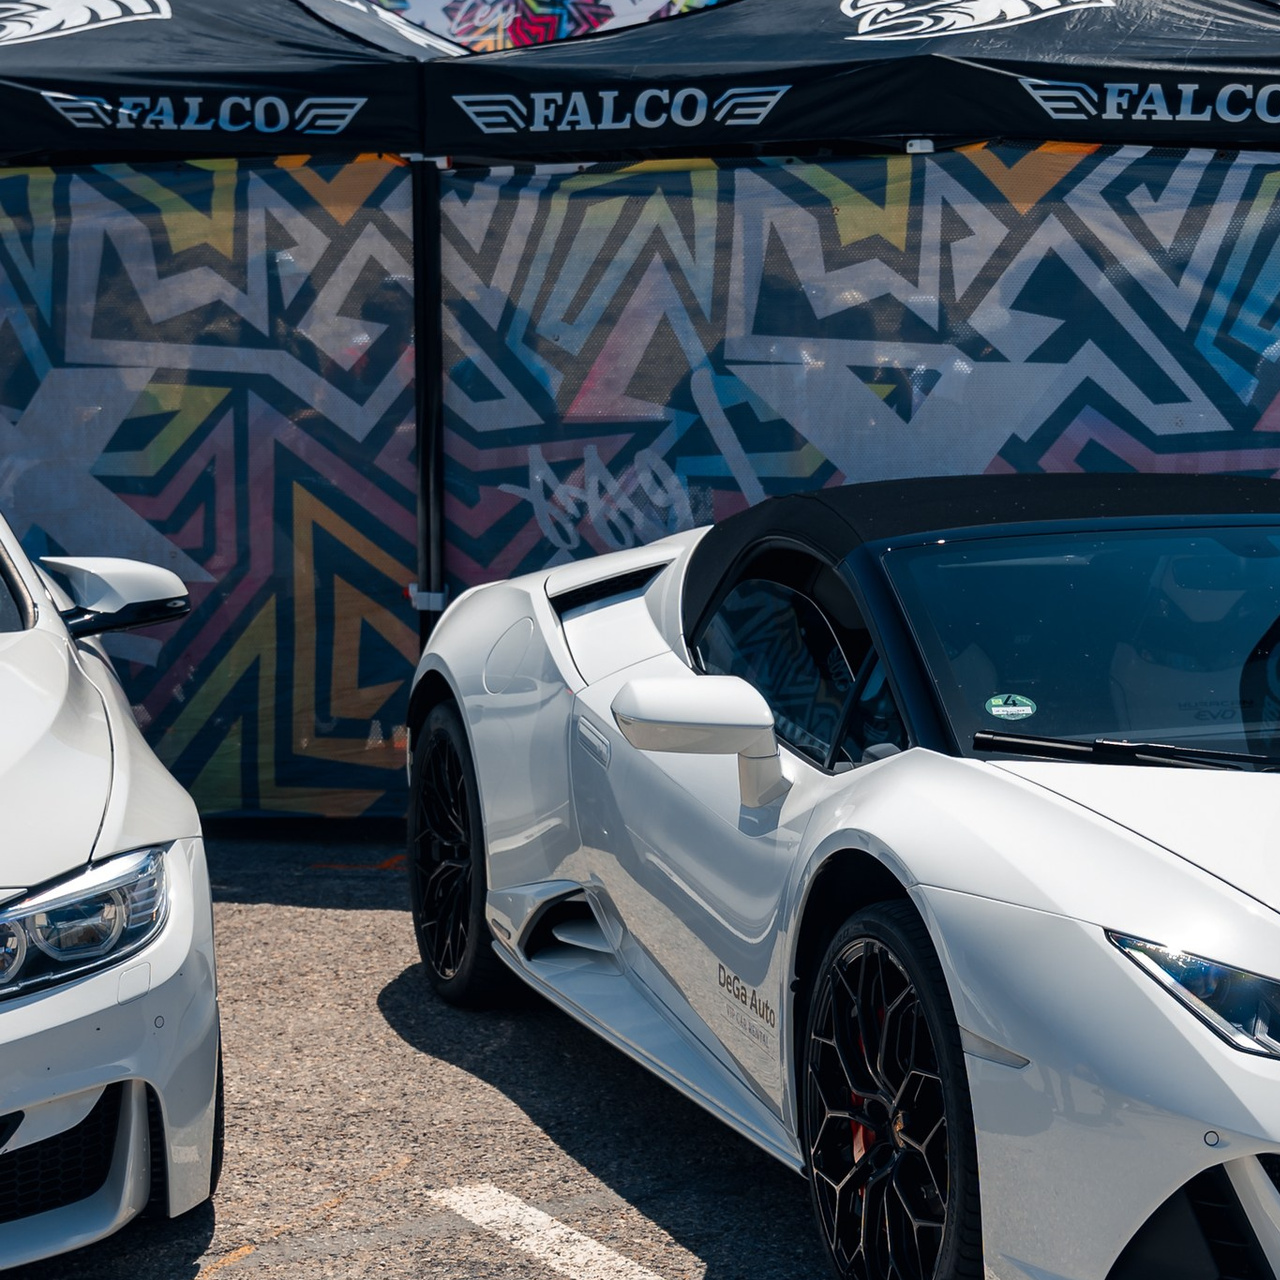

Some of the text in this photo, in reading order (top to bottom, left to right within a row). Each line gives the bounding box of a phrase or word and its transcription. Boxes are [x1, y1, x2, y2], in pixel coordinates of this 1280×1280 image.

[115, 96, 291, 133] FALCO
[530, 88, 708, 133] FALCO
[718, 963, 776, 1029] DeGa Auto
